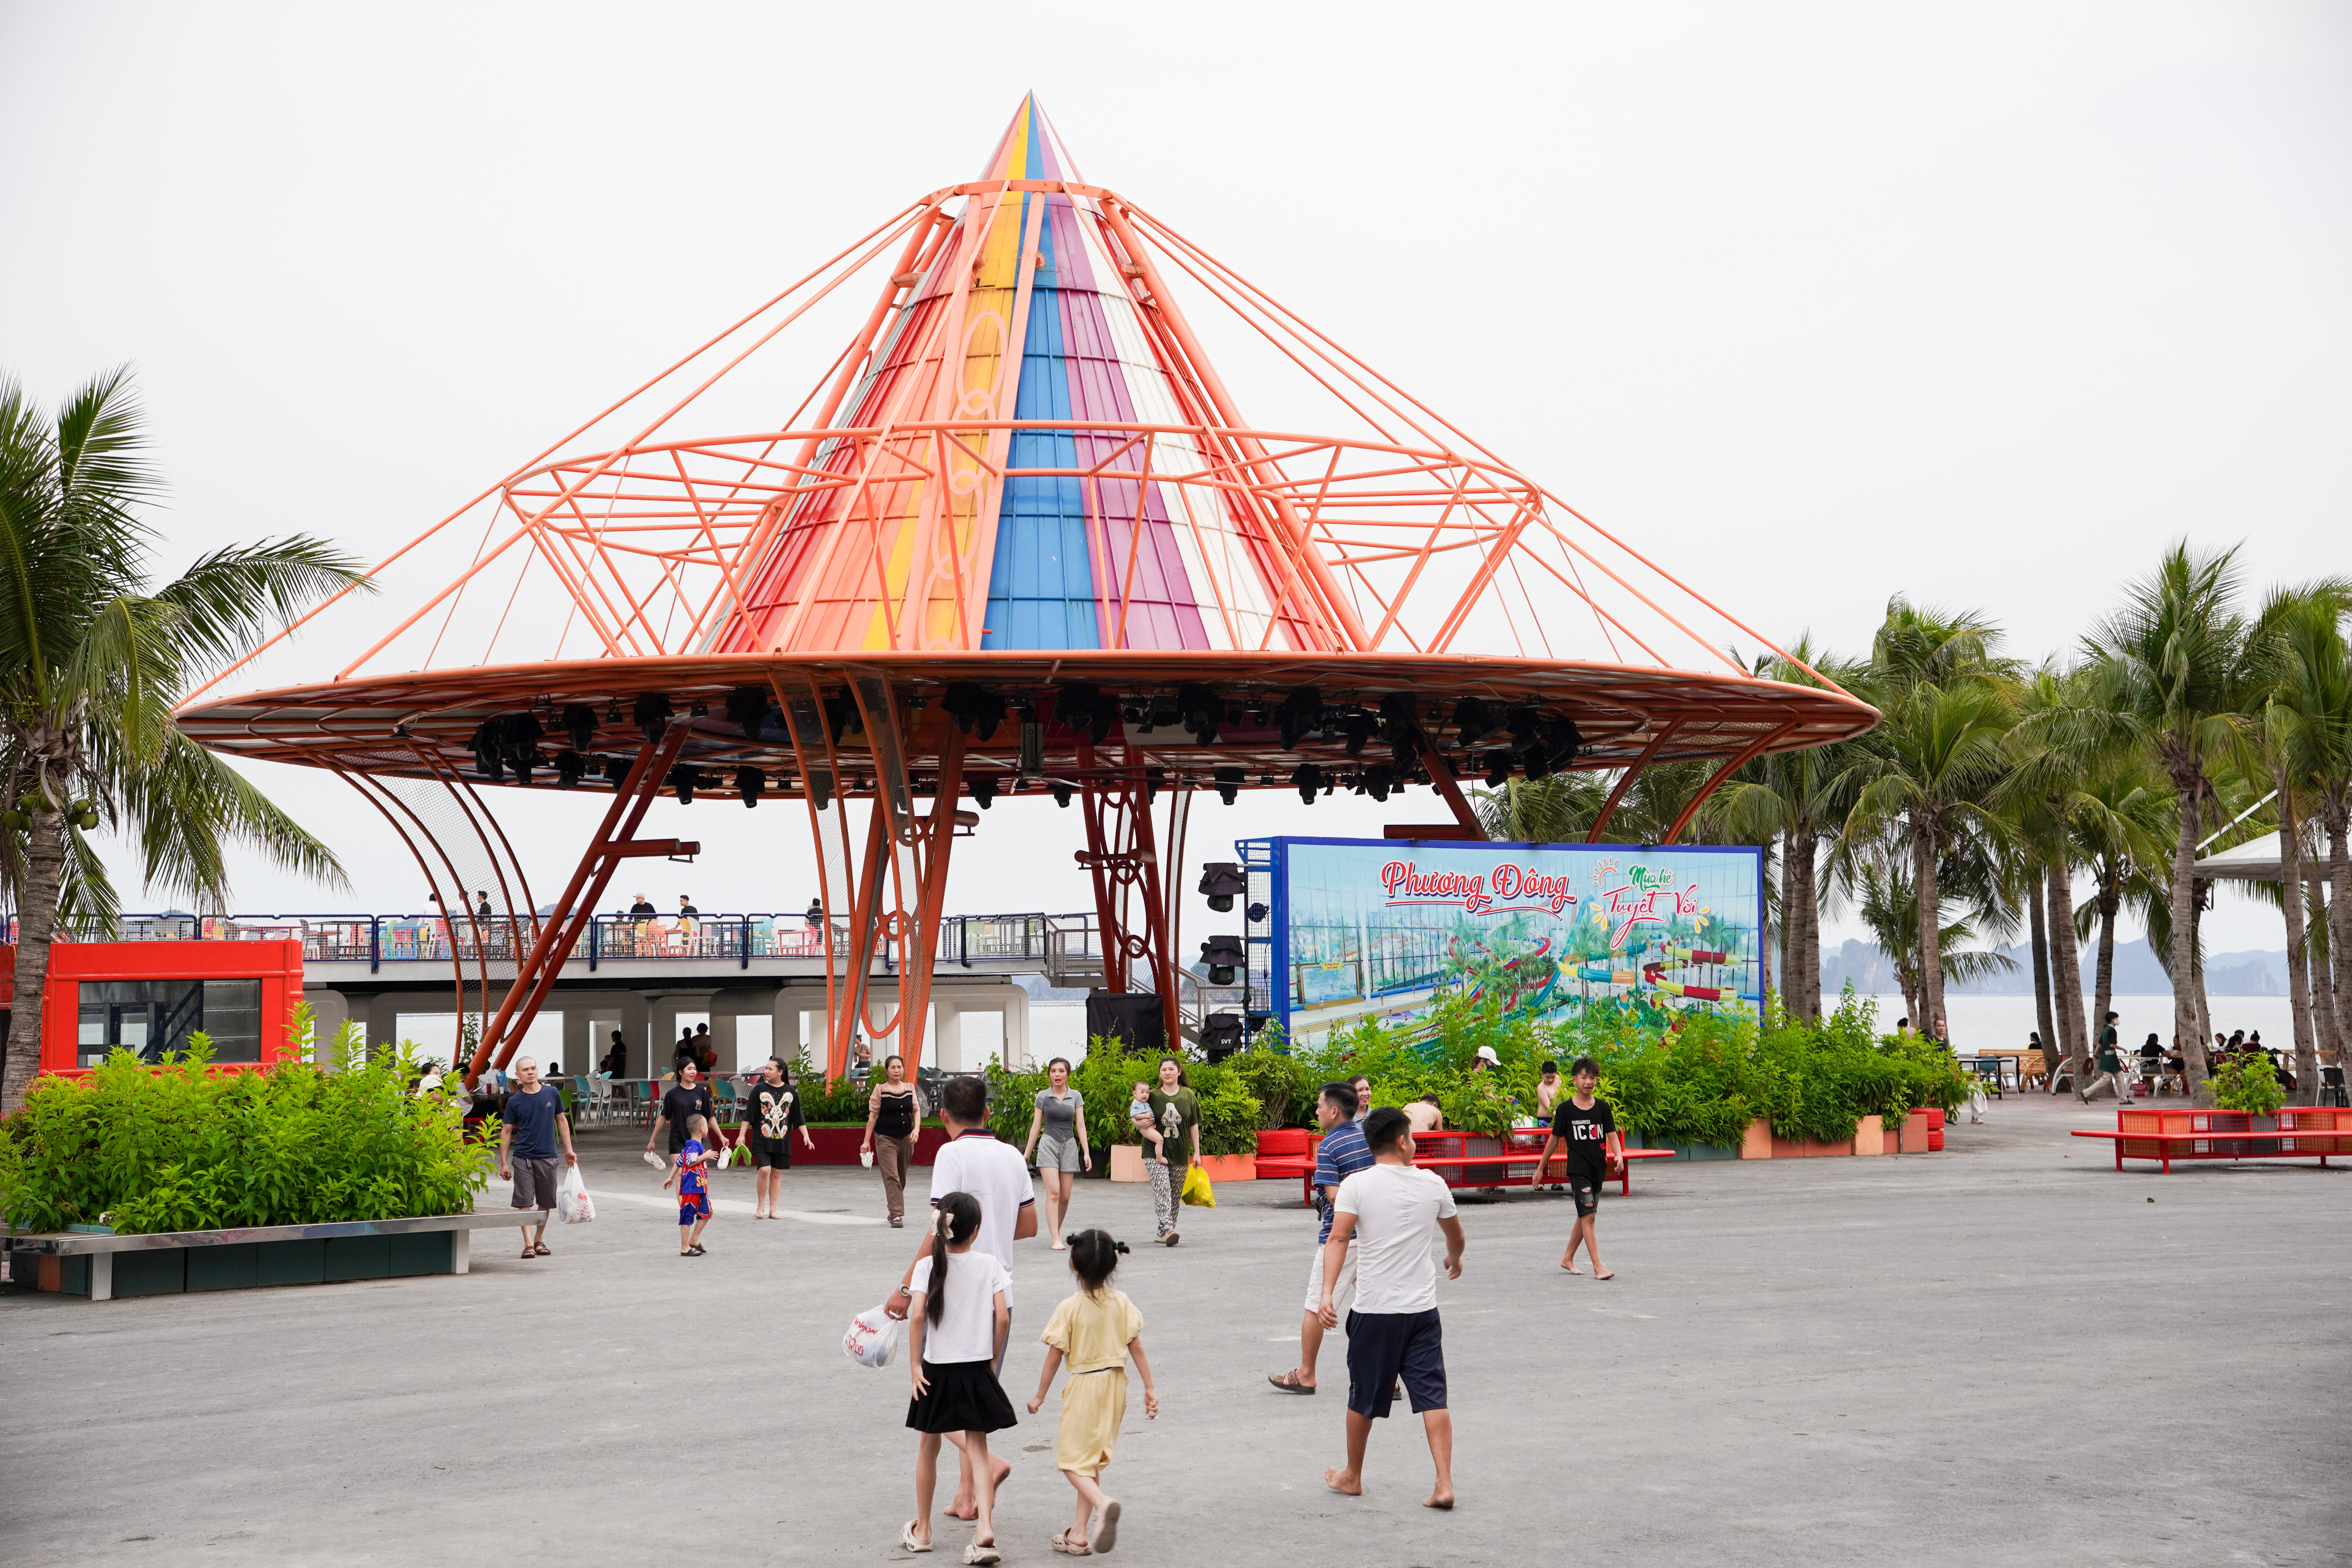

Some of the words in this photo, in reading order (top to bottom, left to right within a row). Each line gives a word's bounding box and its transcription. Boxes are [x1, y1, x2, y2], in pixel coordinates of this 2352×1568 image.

[1382, 862, 1490, 909] Phương
[1492, 864, 1575, 909] Đông
[1629, 865, 1660, 892] Mùa
[1659, 868, 1673, 884] hè
[1602, 886, 1672, 948] Tuyệt
[1675, 884, 1697, 915] Vời
[1573, 1124, 1603, 1140] ICON
